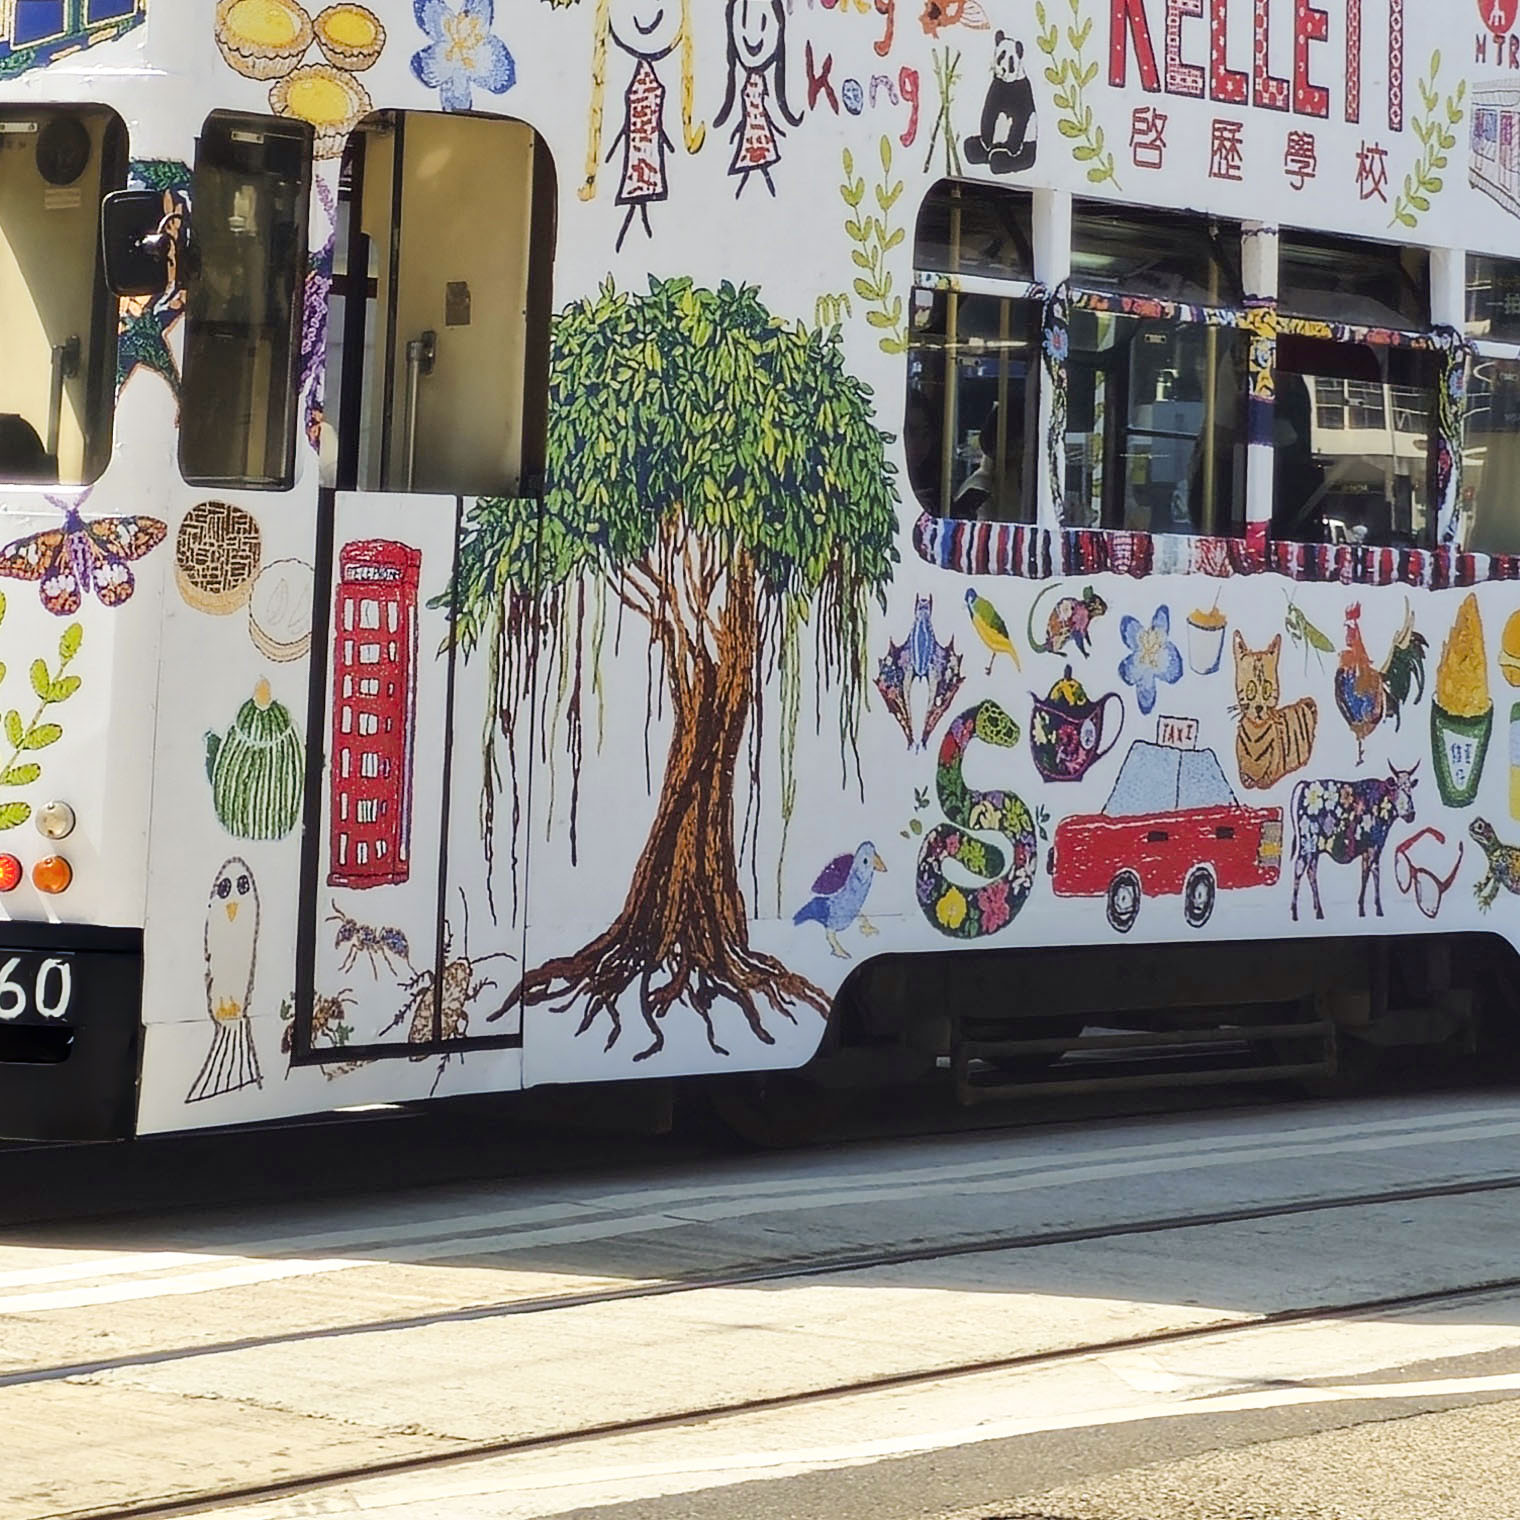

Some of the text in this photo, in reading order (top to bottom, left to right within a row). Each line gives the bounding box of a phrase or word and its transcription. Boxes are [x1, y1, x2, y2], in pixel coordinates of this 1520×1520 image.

[1476, 33, 1520, 70] MTR
[805, 39, 920, 147] Kong
[1162, 723, 1193, 744] TAXI
